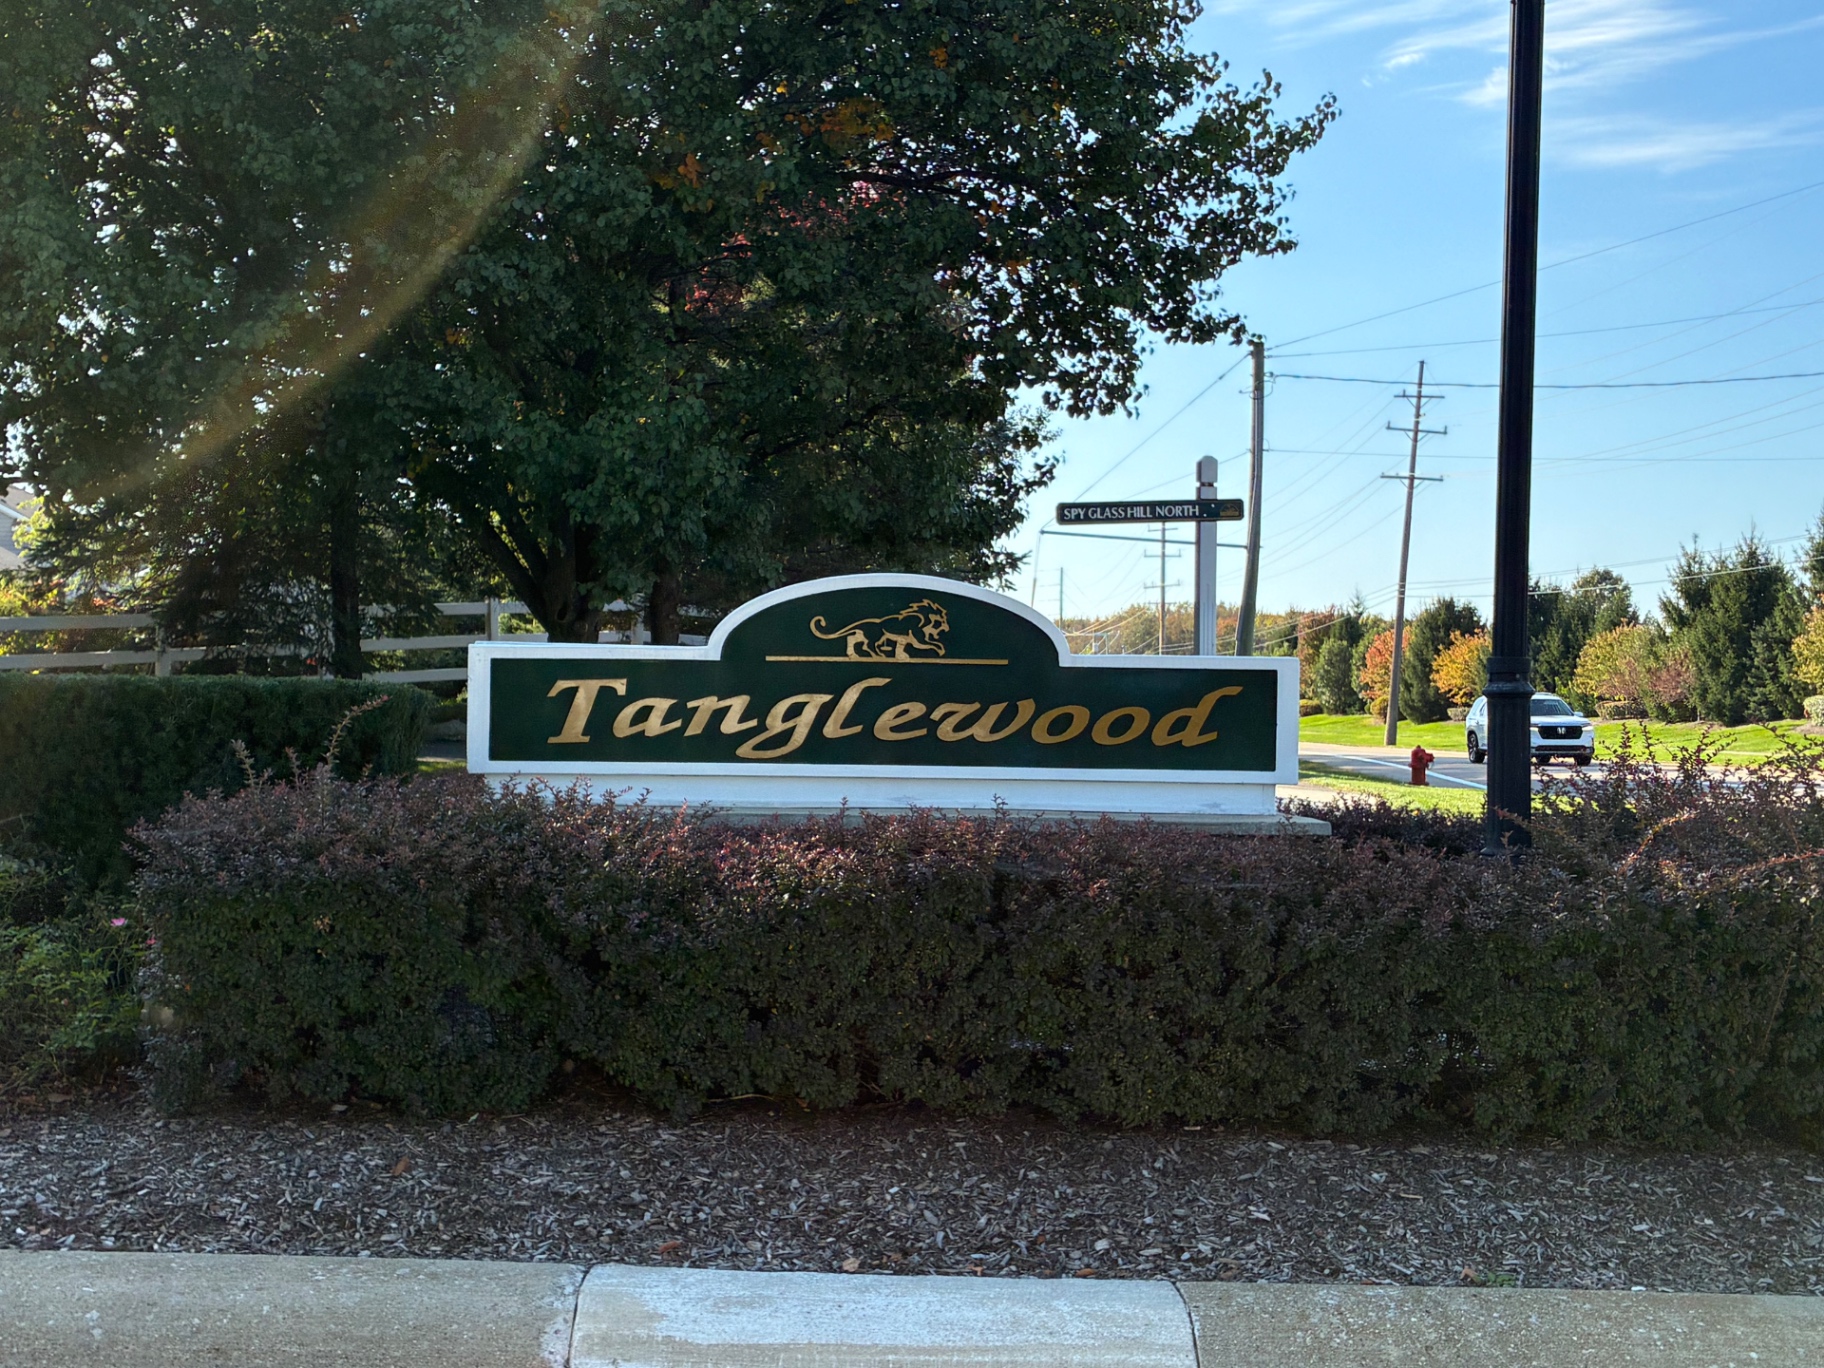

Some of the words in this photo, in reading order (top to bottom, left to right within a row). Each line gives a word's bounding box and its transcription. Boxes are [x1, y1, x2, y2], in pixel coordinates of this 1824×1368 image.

[1063, 507, 1086, 519] SPY
[1088, 506, 1125, 518] GLASS
[1127, 505, 1153, 518] HILL
[1155, 505, 1199, 517] NORTH
[546, 677, 1243, 759] Tanglewood
